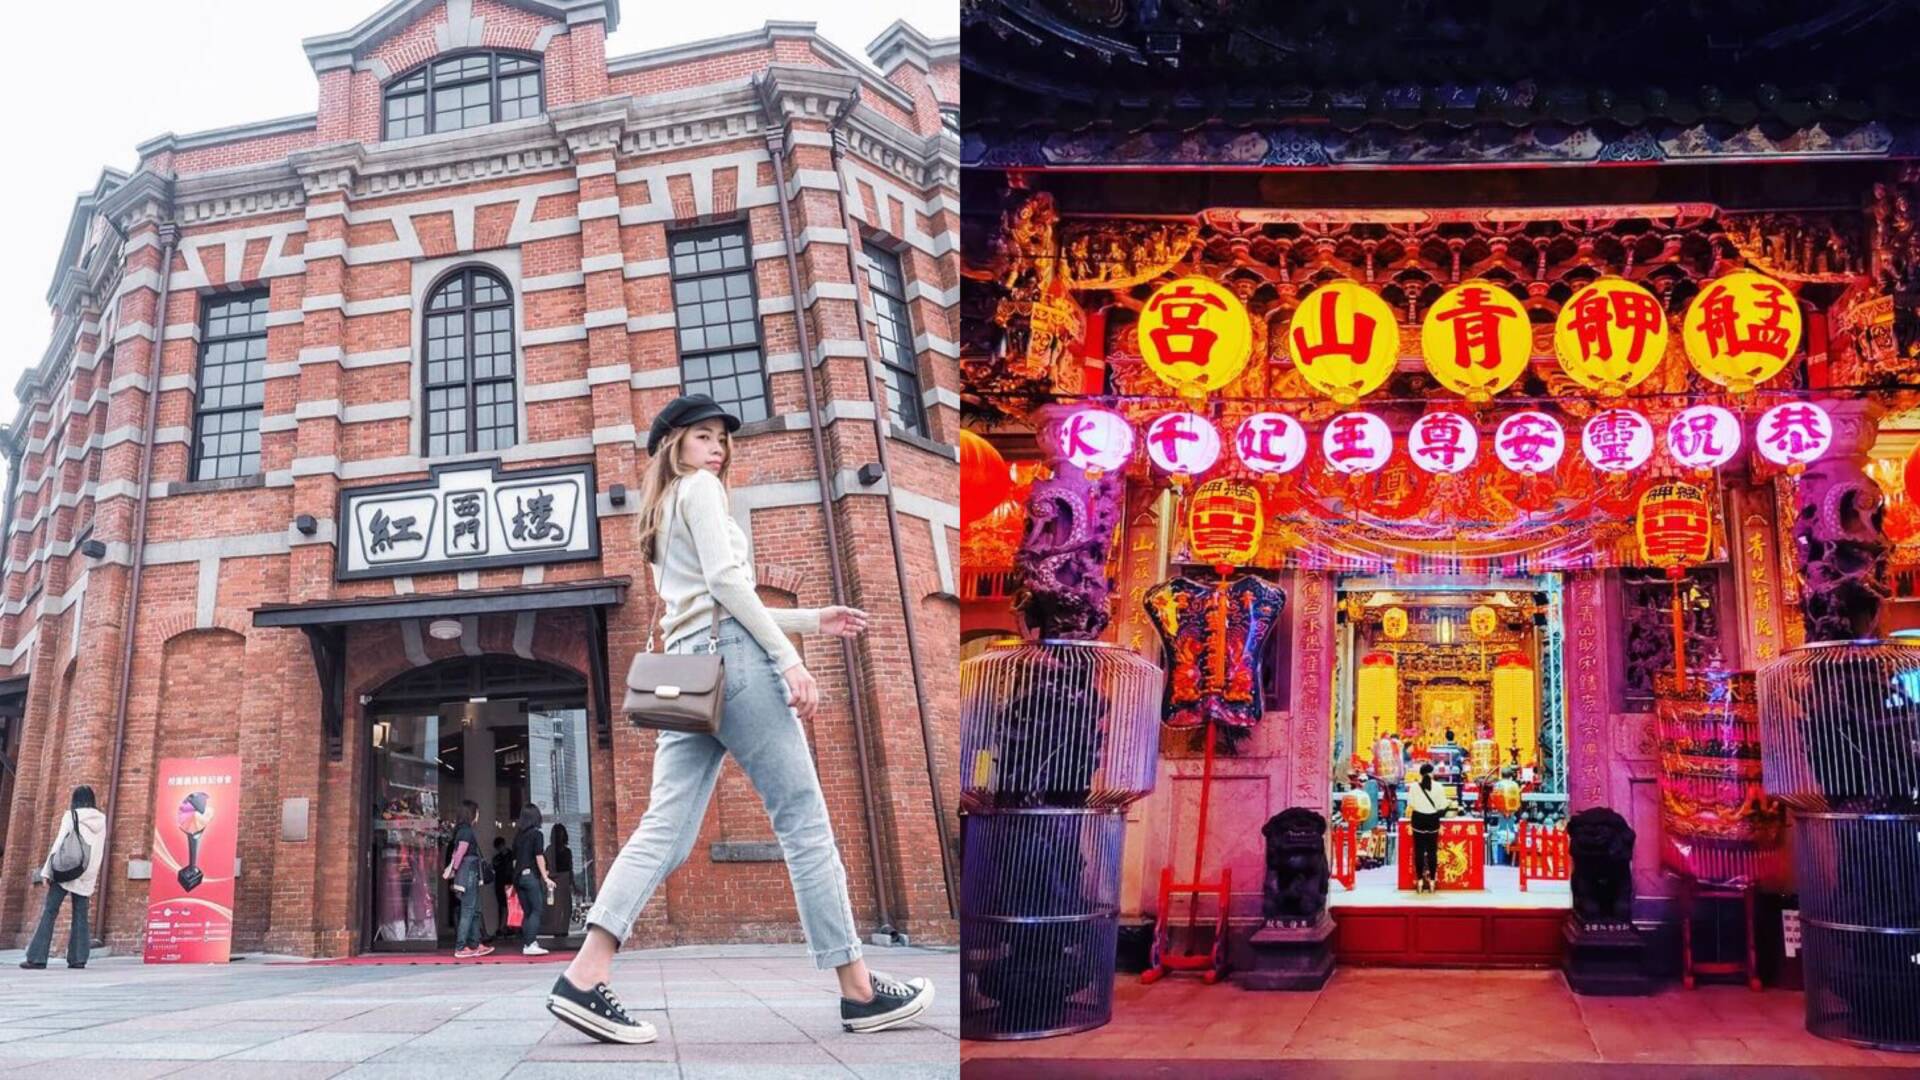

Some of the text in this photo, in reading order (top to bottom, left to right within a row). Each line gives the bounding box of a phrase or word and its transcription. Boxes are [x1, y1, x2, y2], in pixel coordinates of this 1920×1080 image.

[1148, 283, 1789, 366] 艋舺青山宮
[452, 494, 480, 549] 西門
